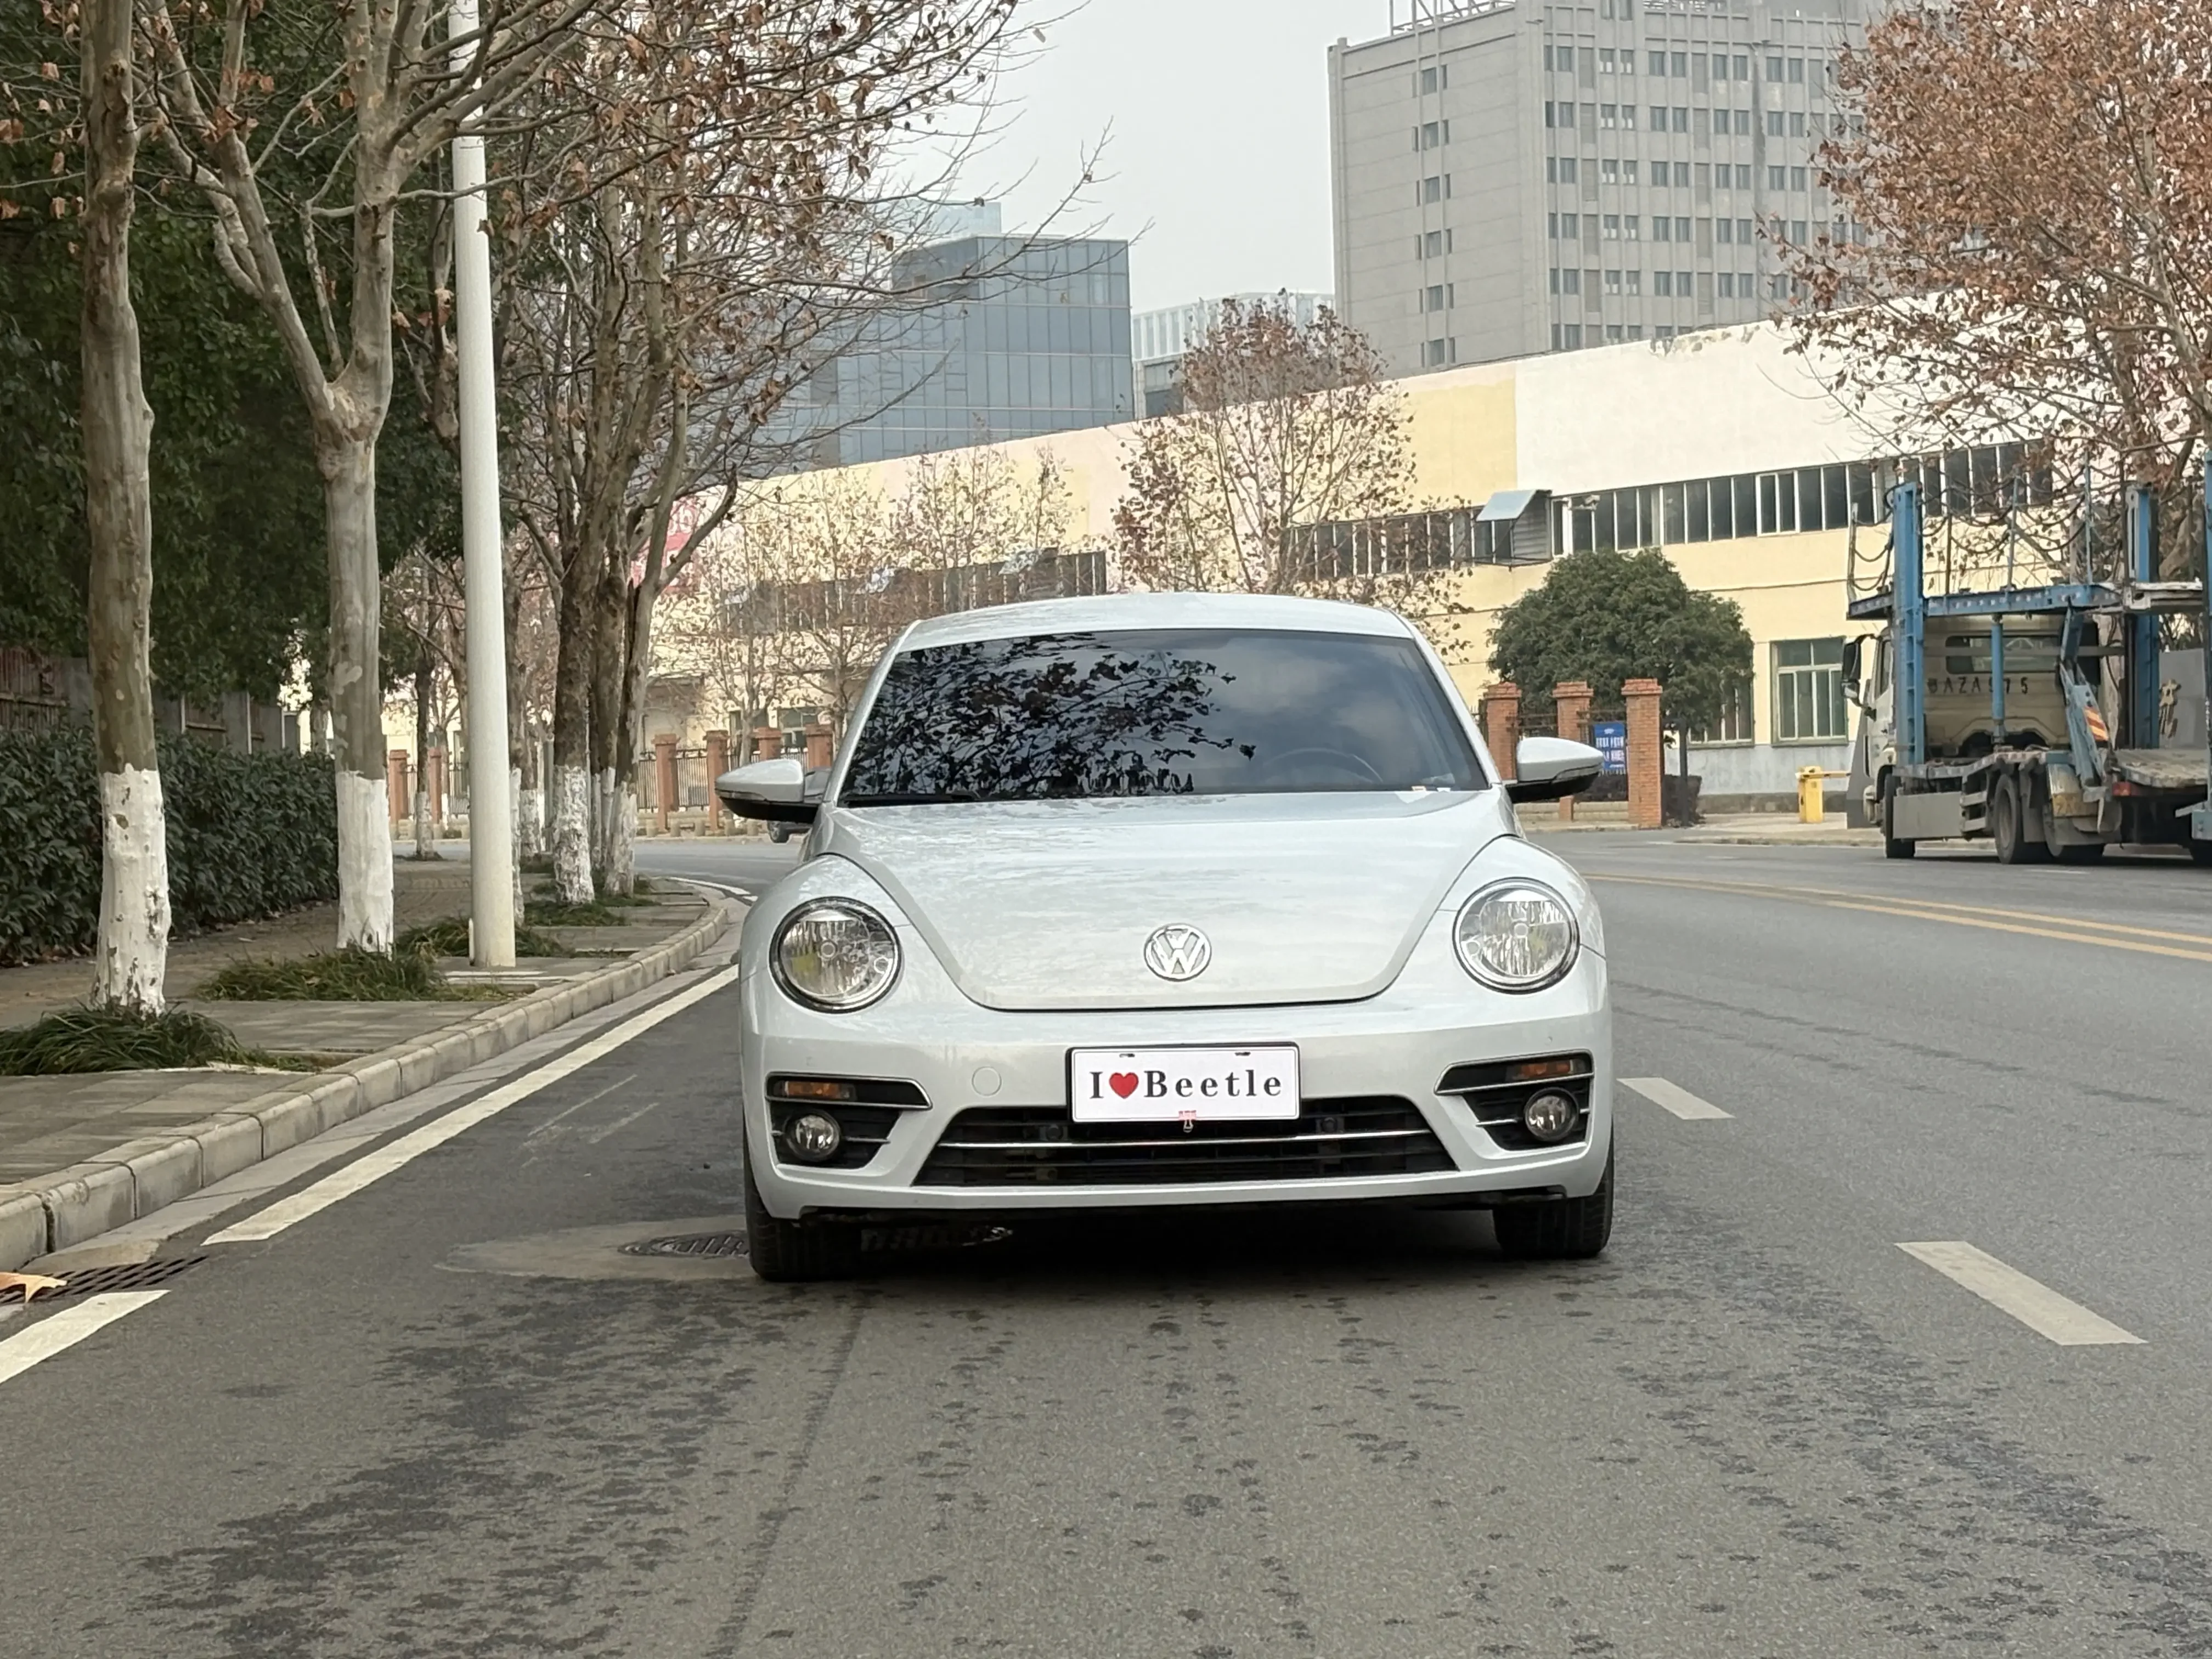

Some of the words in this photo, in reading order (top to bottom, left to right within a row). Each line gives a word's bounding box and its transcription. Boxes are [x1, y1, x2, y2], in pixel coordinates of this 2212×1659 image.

[1143, 923, 1212, 982] VW
[1090, 1071, 1104, 1099] I
[1143, 1069, 1282, 1098] Beetle
